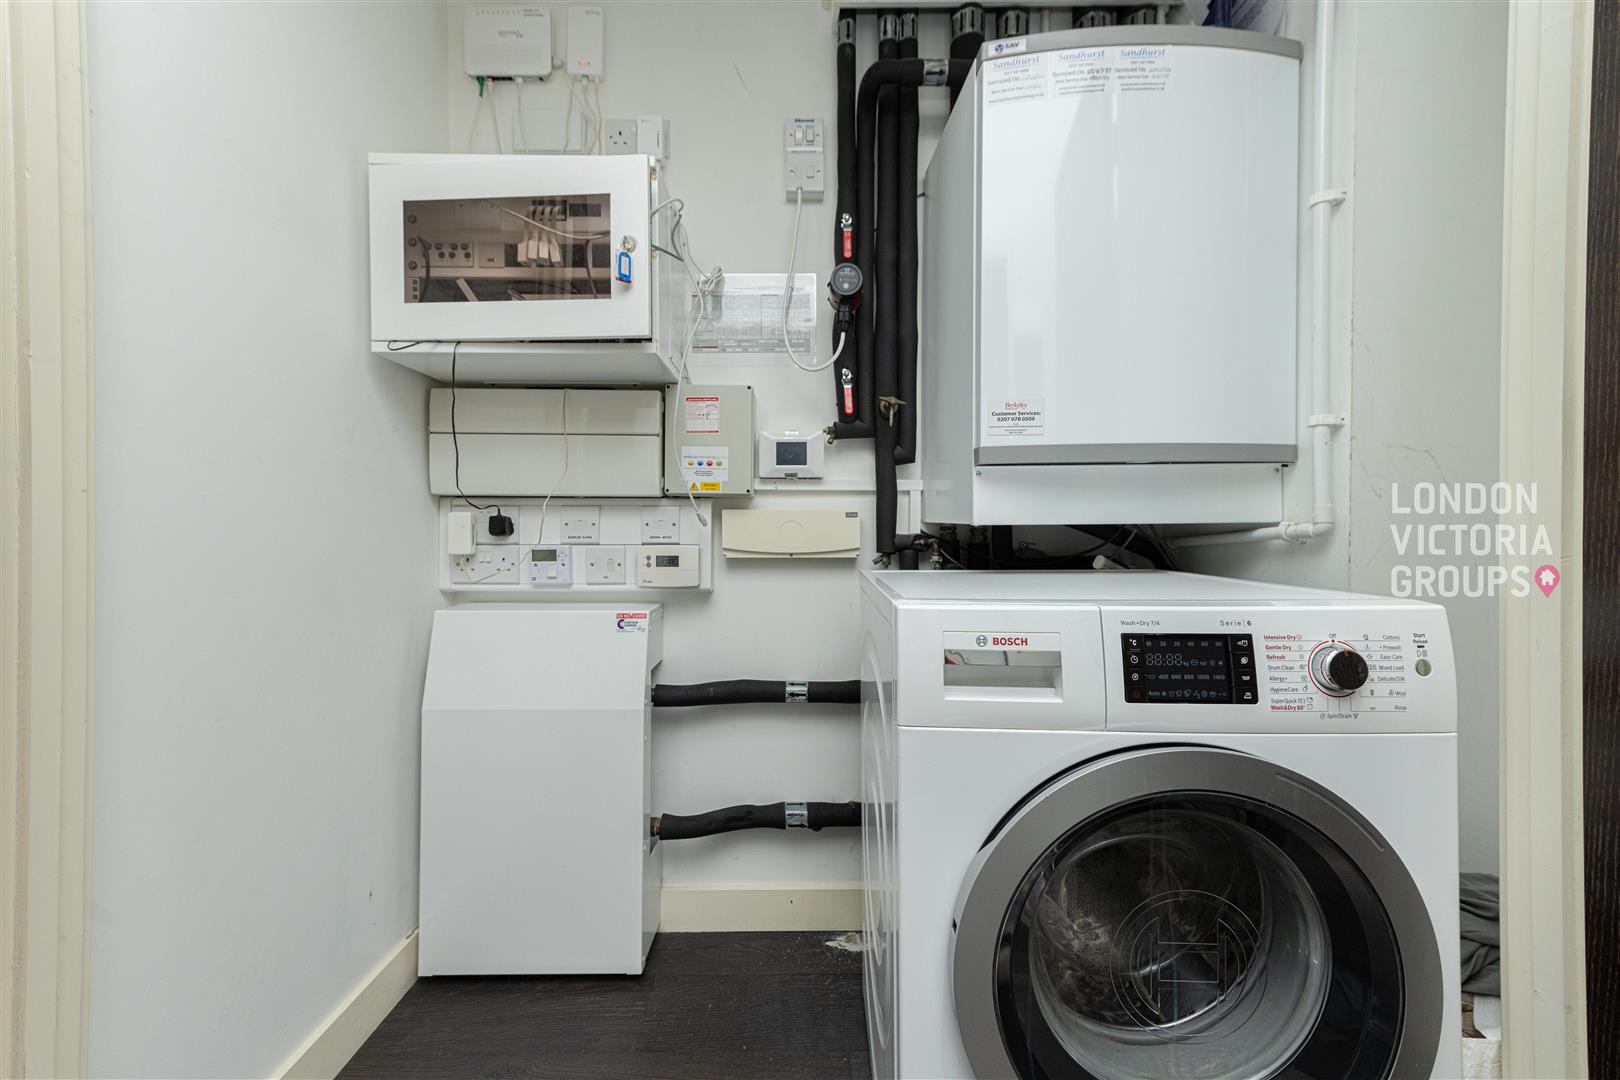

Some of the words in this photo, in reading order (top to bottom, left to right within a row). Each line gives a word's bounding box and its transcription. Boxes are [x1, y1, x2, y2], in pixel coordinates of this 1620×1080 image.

[1005, 41, 1020, 49] SAV
[1058, 50, 1105, 61] Sandhurst
[1120, 48, 1166, 57] Sandhurst
[993, 55, 1040, 68] Sandhurst
[992, 637, 1028, 646] BOSCH
